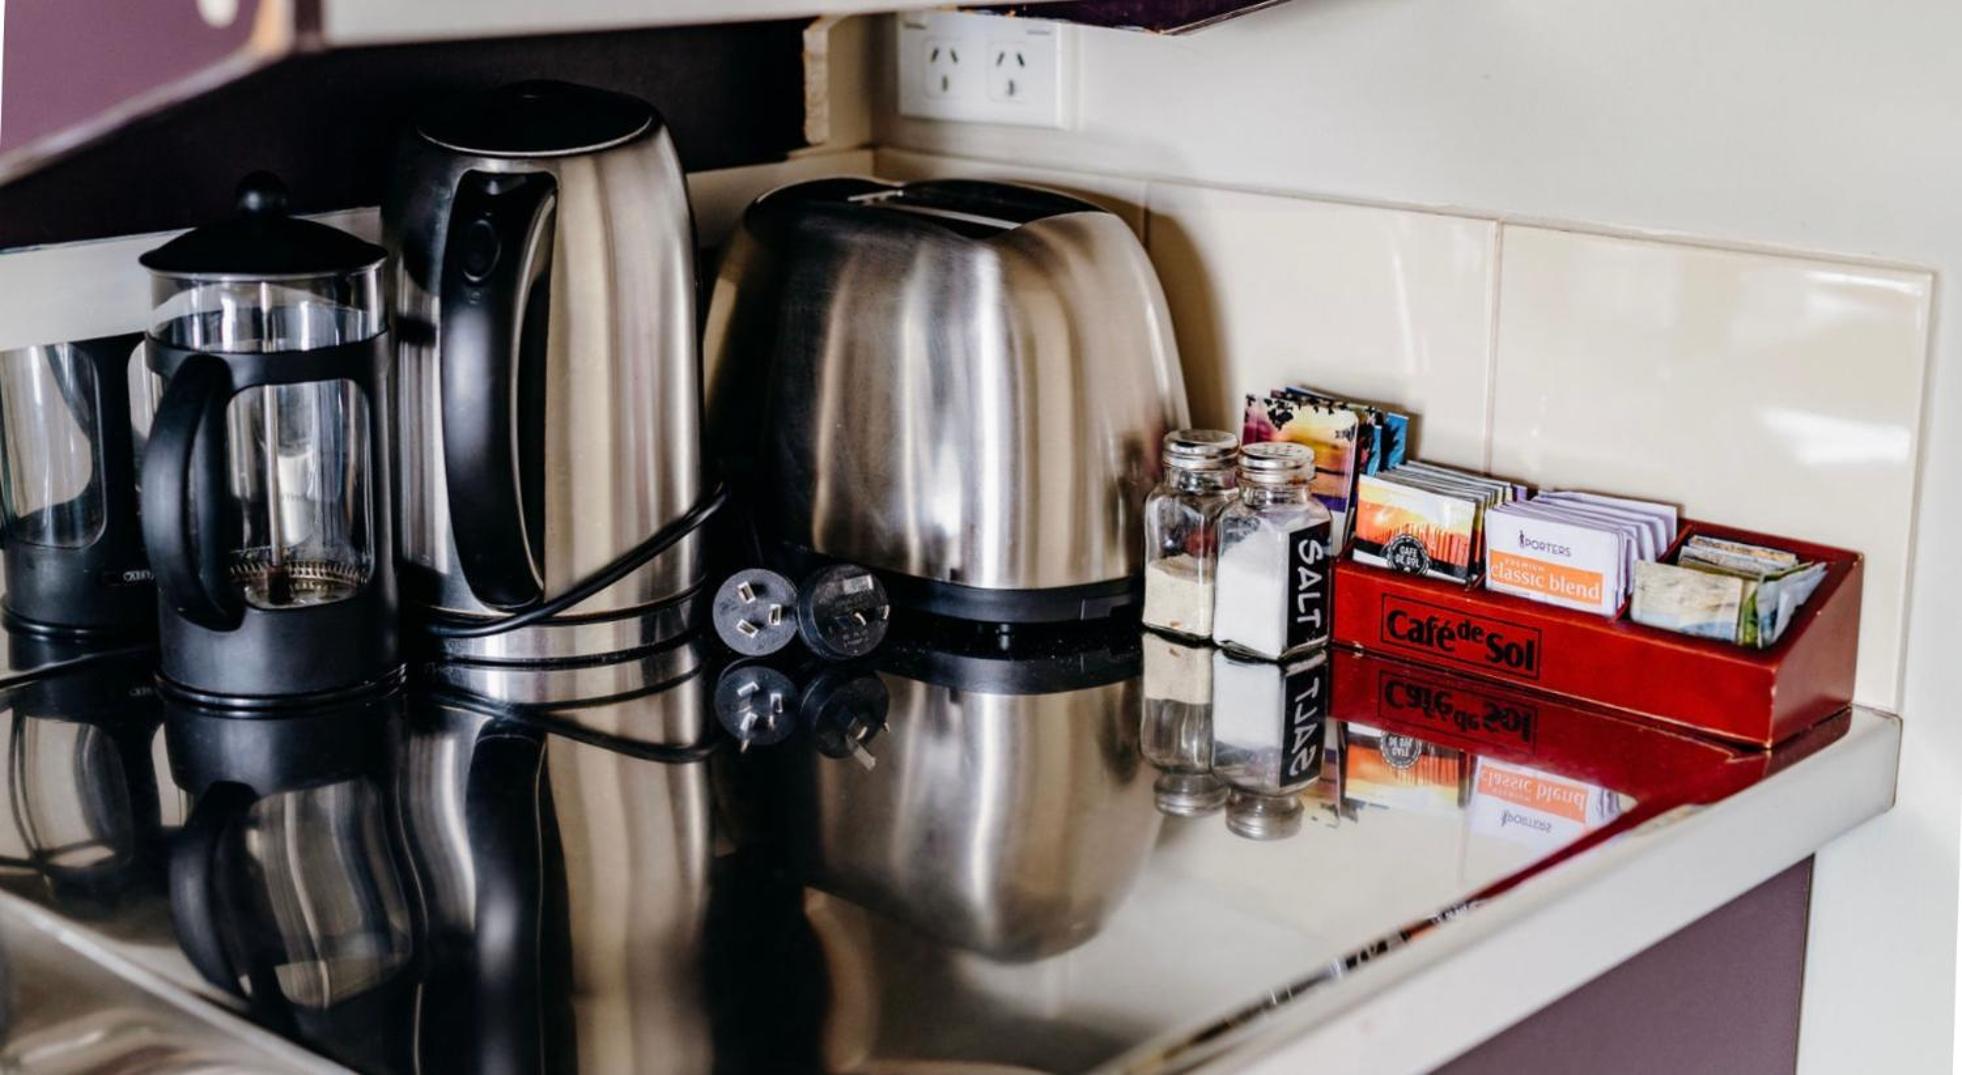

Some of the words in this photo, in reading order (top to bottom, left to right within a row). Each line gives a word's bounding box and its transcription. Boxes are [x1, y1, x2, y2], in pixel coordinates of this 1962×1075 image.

[1524, 537, 1571, 557] PORTERS
[1297, 538, 1324, 629] SALT
[1490, 560, 1545, 588] classic
[1549, 573, 1600, 600] blend
[1387, 609, 1456, 652] Café
[1457, 619, 1484, 644] de
[1486, 632, 1535, 671] Sol
